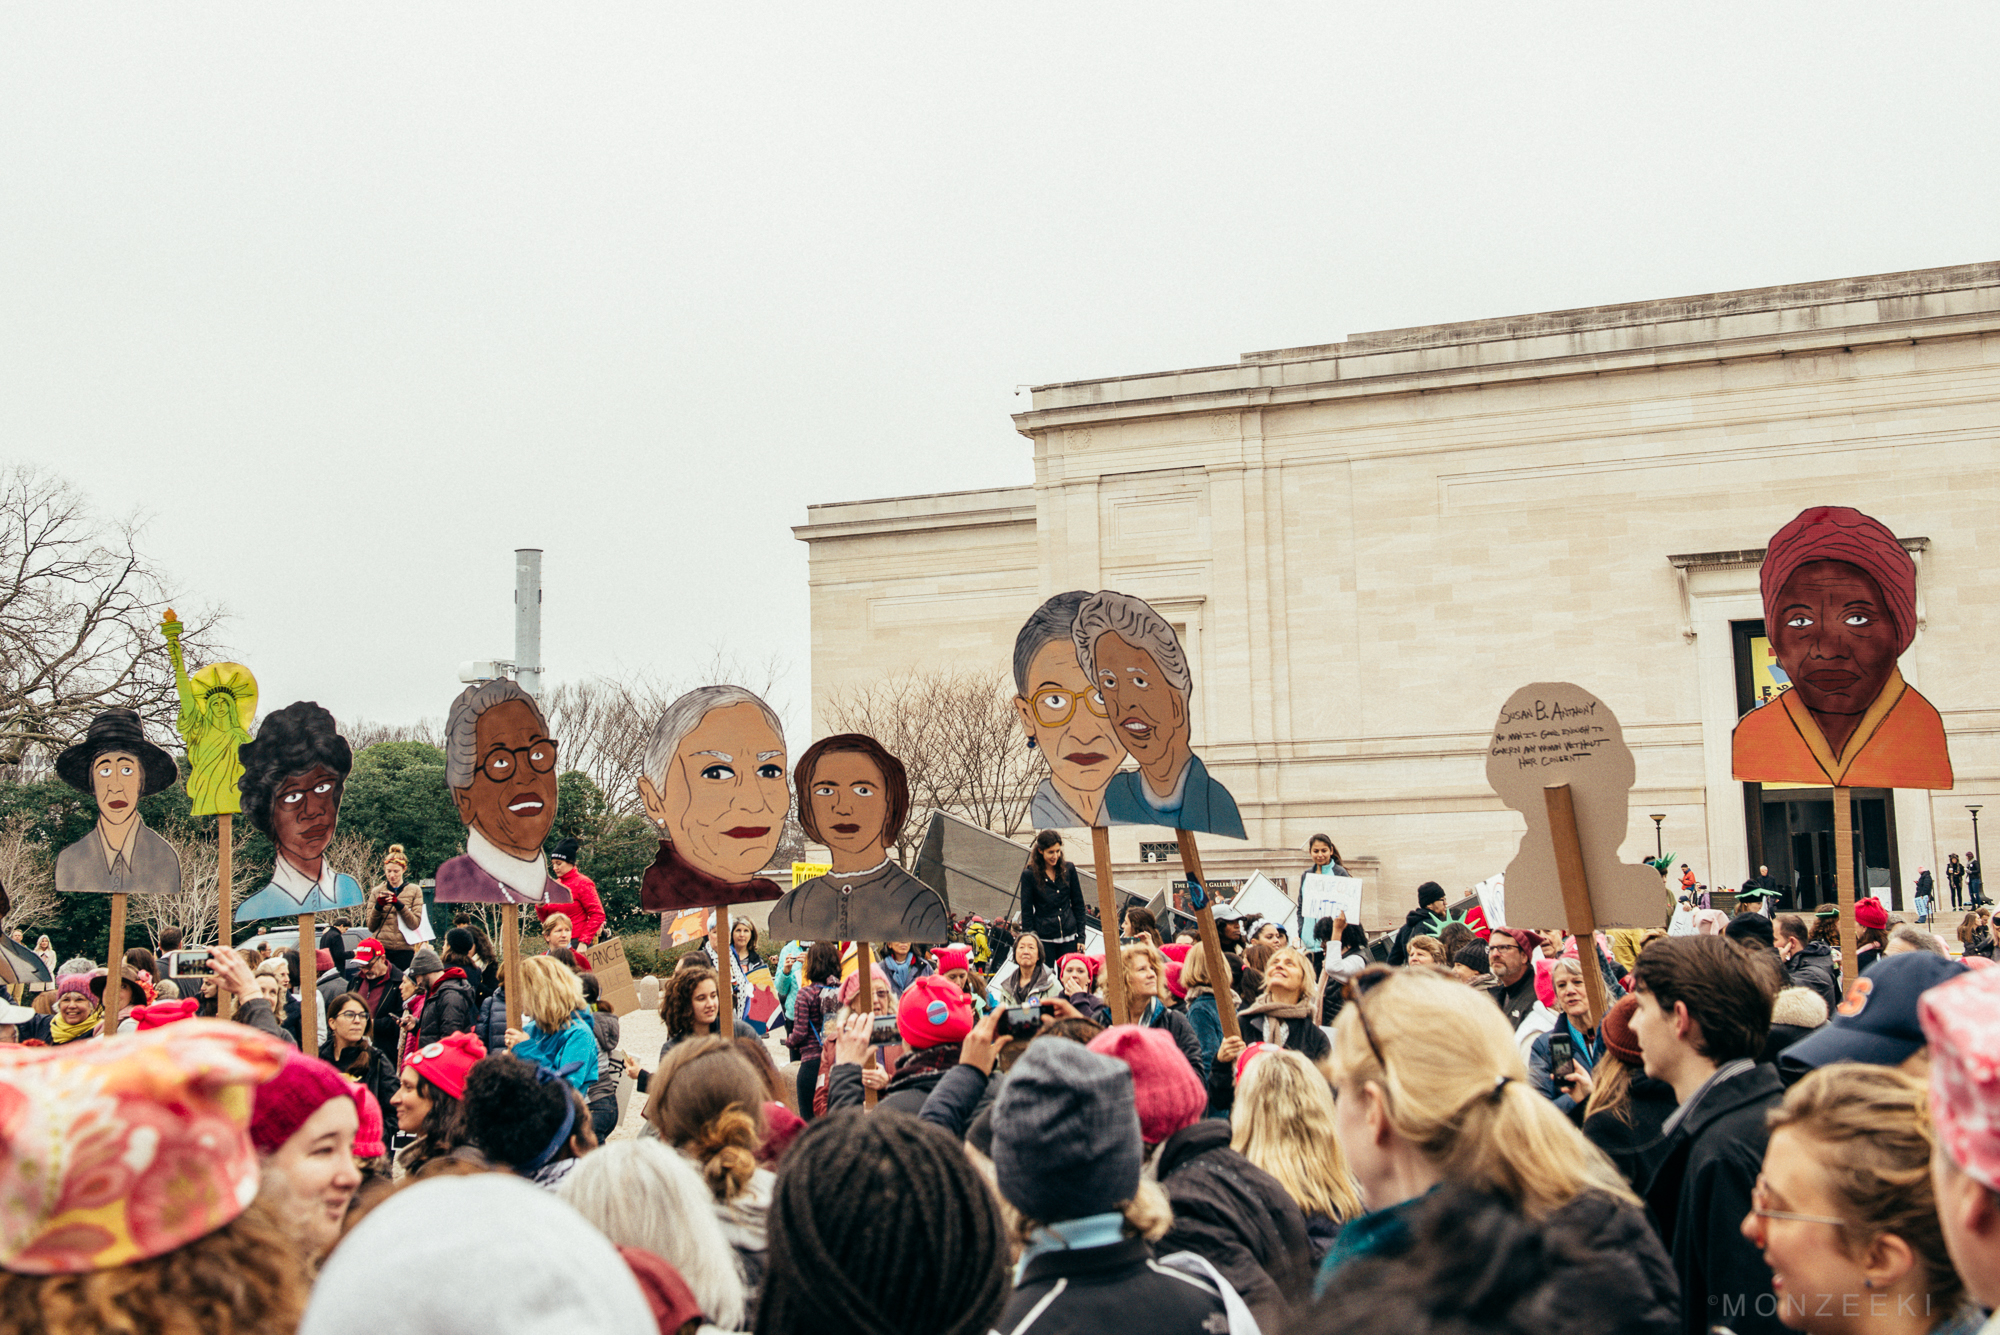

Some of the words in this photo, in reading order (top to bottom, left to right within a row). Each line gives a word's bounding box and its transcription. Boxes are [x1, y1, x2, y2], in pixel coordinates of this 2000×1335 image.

[1500, 704, 1533, 724] SUSAN
[1535, 699, 1549, 720] B.
[1551, 701, 1596, 720] ANTHONY
[1508, 731, 1523, 741] MAN
[1562, 725, 1589, 736] ENOUGH
[1491, 746, 1520, 756] GOVERN
[1524, 745, 1536, 754] ANY
[1519, 756, 1538, 769] HER
[1541, 753, 1591, 766] CONSENT
[1836, 976, 1873, 1017] S
